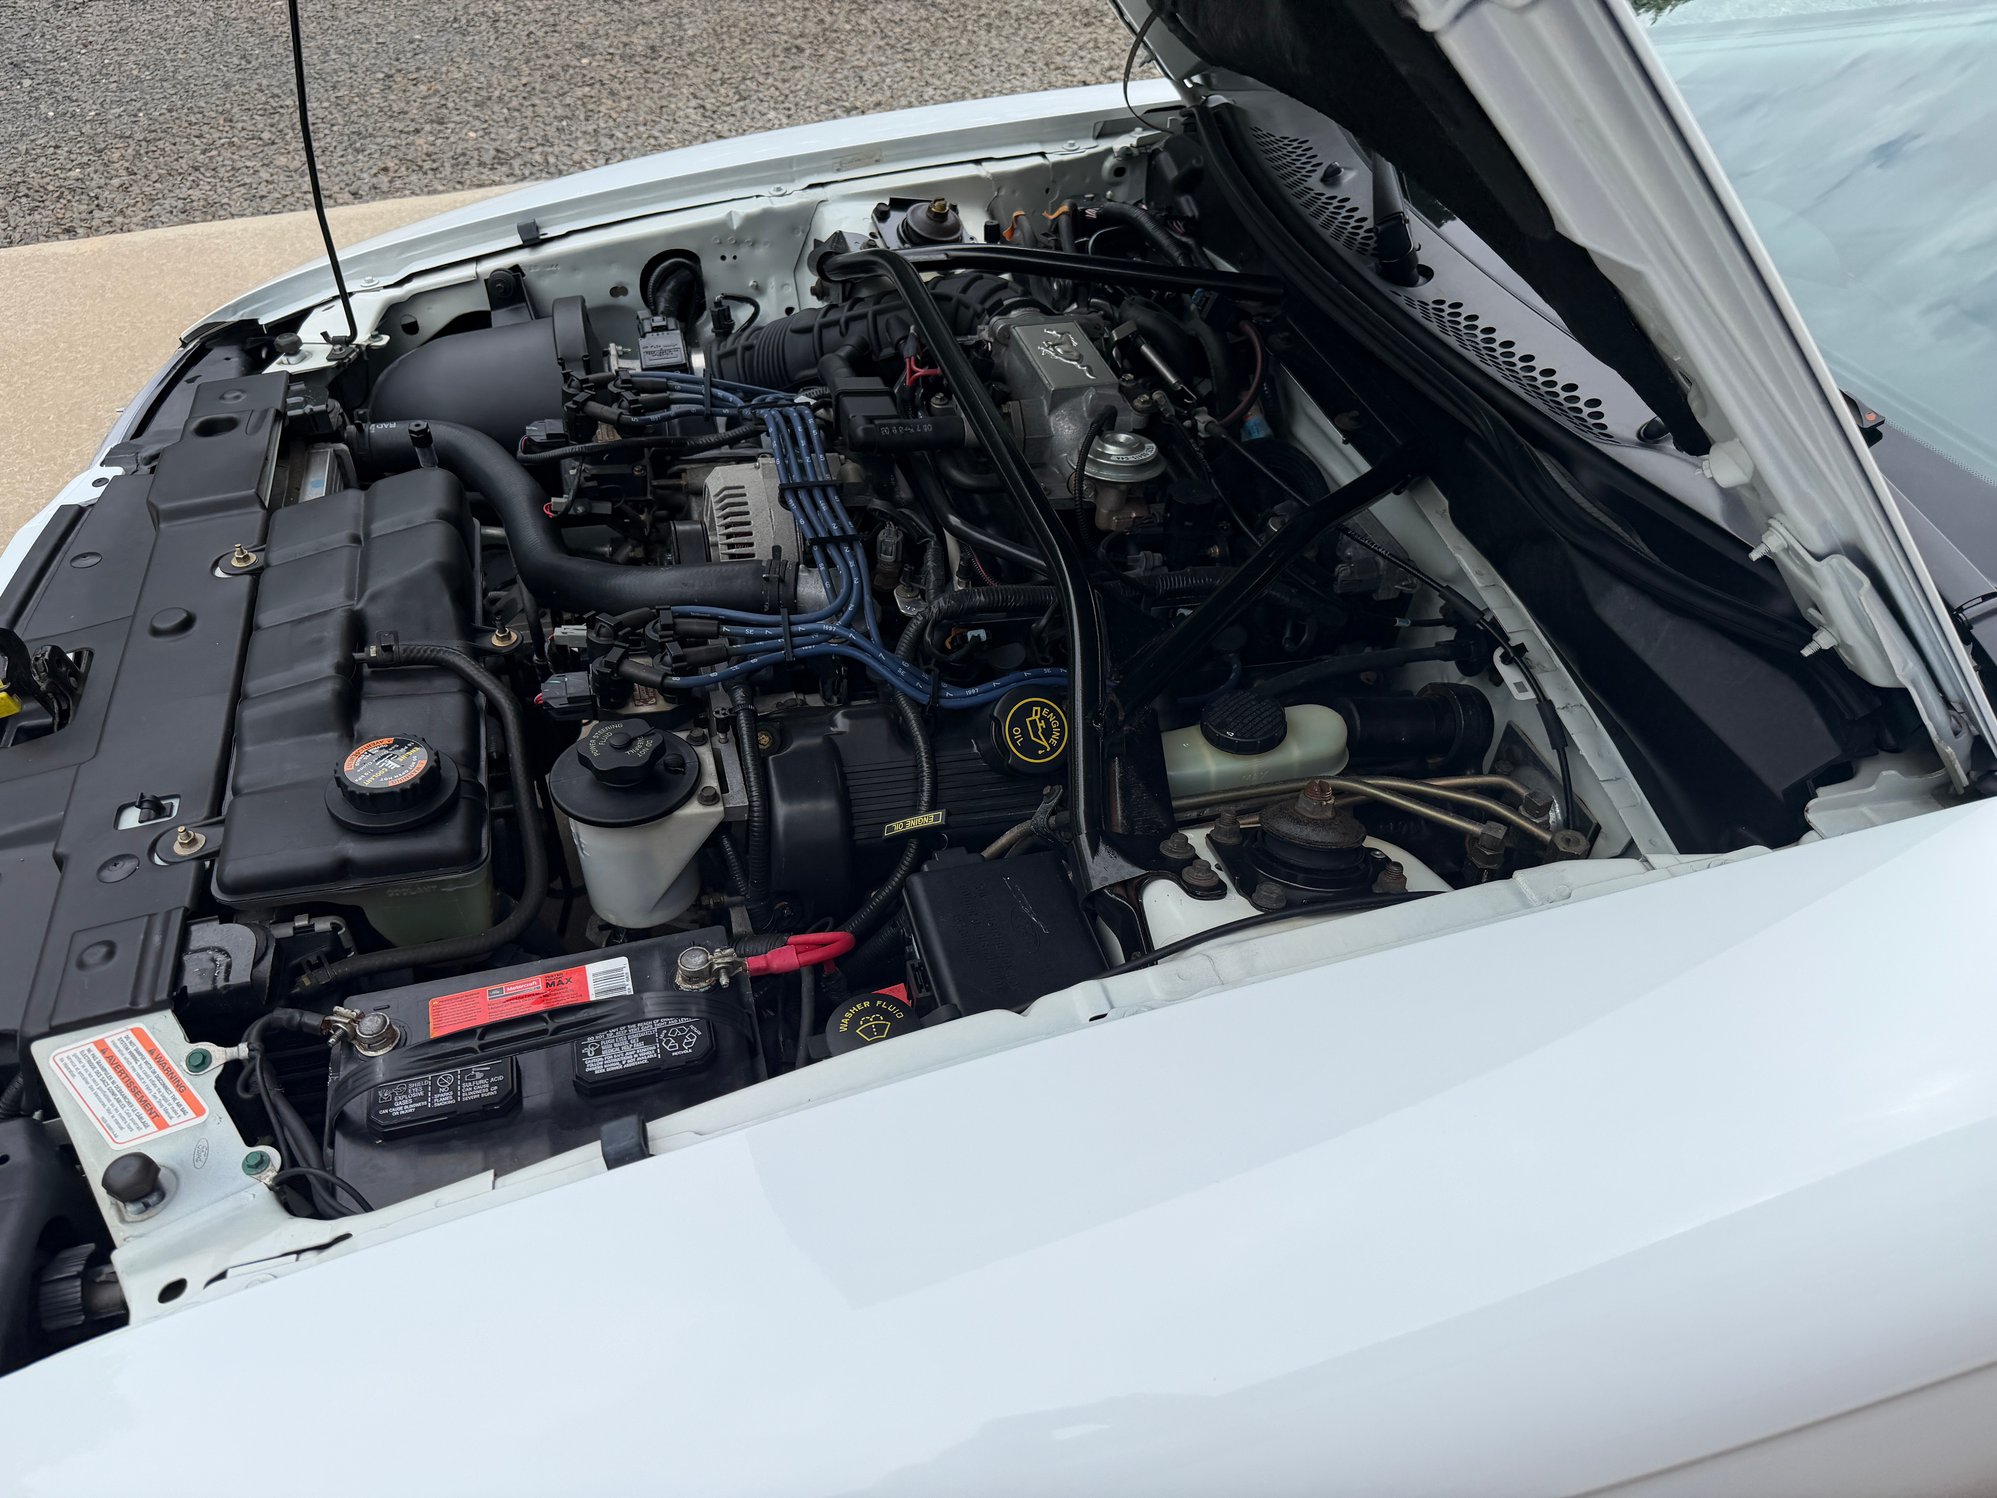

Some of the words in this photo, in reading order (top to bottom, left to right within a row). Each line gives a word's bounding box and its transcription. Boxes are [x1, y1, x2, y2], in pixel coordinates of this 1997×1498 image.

[798, 625, 806, 633] 7
[878, 652, 886, 661] 7
[897, 668, 906, 677] SE
[916, 681, 923, 689] 7
[593, 723, 623, 739] STEERING
[1041, 708, 1061, 747] ENGINE
[599, 731, 613, 746] FLUID
[1012, 727, 1024, 747] OIL
[400, 746, 420, 761] ENGINE
[589, 739, 600, 757] POWER
[637, 747, 649, 758] NOT
[363, 768, 388, 785] COOLANT
[394, 769, 409, 778] OPEN
[893, 823, 903, 831] OIL
[906, 815, 934, 828] ENGINE
[506, 980, 537, 992] Motorcraft
[545, 977, 572, 988] MAX
[839, 1001, 870, 1033] WASHER
[876, 1000, 904, 1019] FLUID
[152, 1053, 188, 1093] WARNING
[104, 1054, 159, 1119] AVERTISSEMENT
[409, 1080, 429, 1088] SHIELD
[462, 1079, 489, 1088] SULFURIC
[490, 1075, 504, 1083] ACID
[395, 1091, 424, 1101] EXPLOSIVE
[462, 1088, 489, 1097] BLINDNESS
[394, 1098, 412, 1106] GASES
